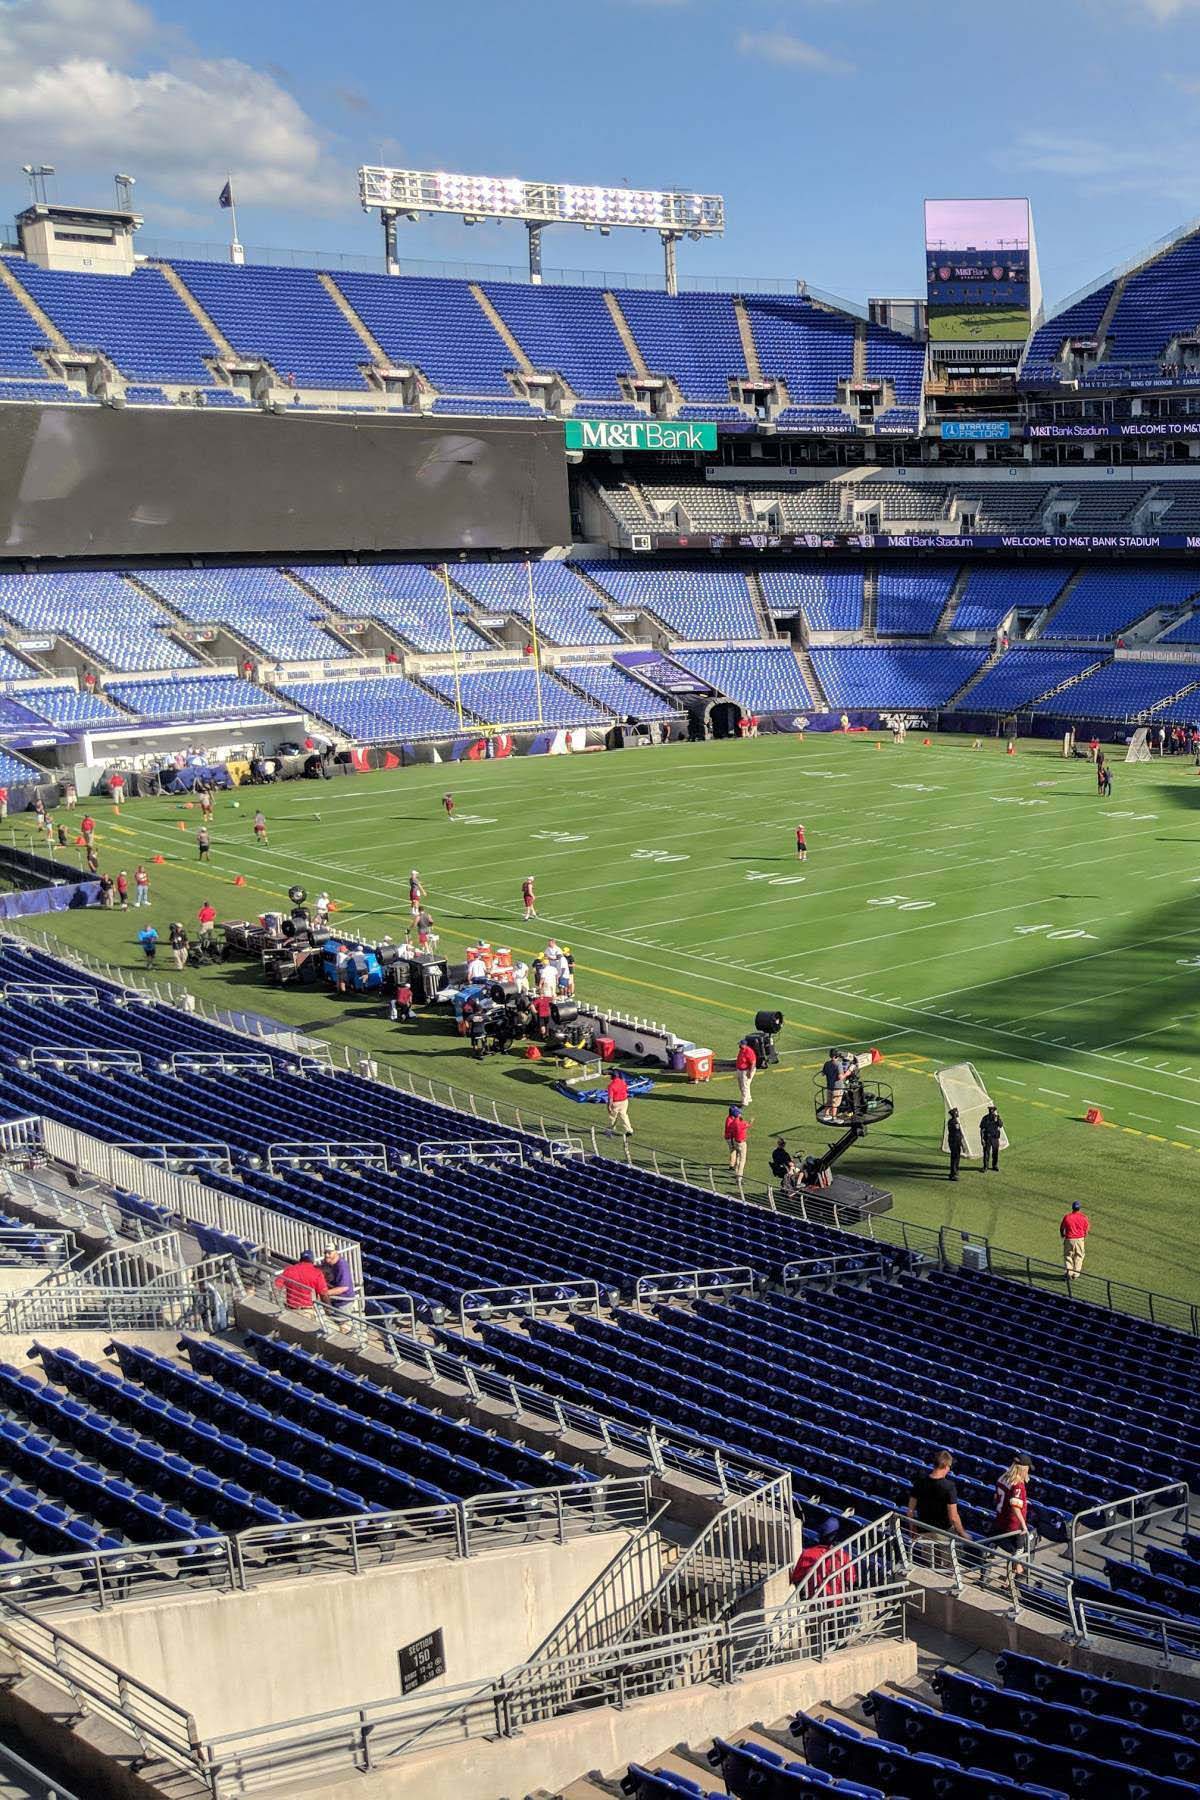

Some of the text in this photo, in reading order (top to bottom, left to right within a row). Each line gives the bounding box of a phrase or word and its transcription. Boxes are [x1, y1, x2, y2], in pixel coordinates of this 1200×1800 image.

[580, 421, 704, 449] M&T Bank
[1030, 425, 1109, 436] M&T Bank Stadium
[1121, 424, 1168, 434] WELCOME
[1168, 424, 1181, 433] TO
[888, 536, 973, 547] M&T Bank Stadium
[1002, 537, 1160, 547] WELCOME TO M&T BANK STADIUM
[886, 720, 929, 729] RVEN
[866, 895, 937, 911] 50
[1013, 923, 1086, 940] 40
[408, 1635, 434, 1657] SECTION
[414, 1648, 431, 1667] 150
